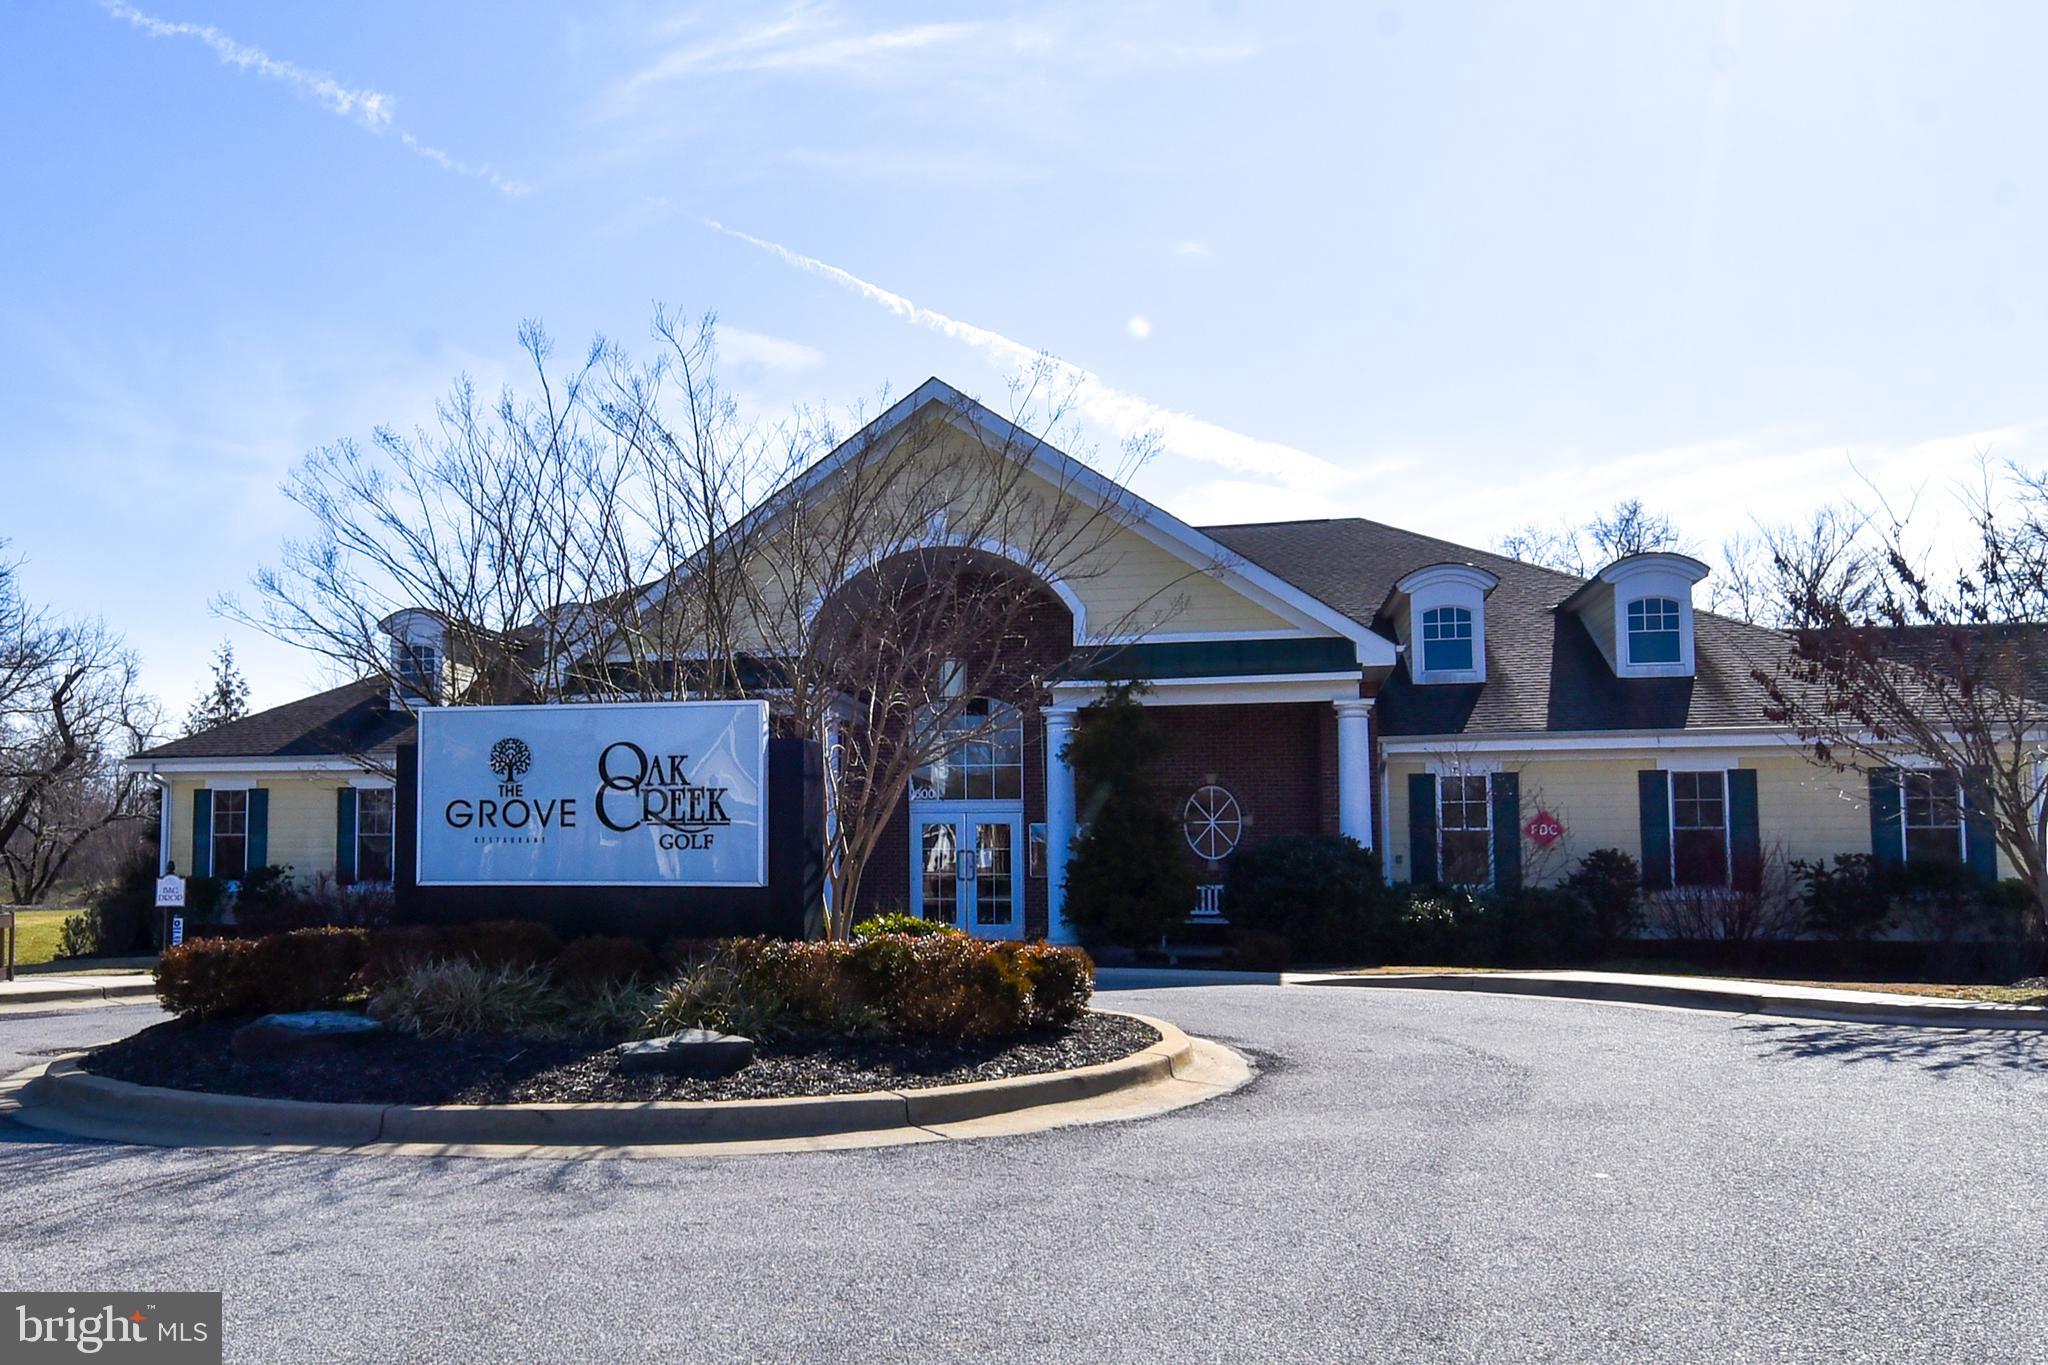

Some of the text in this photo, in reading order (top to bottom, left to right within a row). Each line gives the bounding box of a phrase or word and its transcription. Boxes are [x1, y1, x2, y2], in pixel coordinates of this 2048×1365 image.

[598, 741, 691, 790] OAK
[498, 784, 523, 797] THE
[445, 798, 576, 828] GROVE
[595, 776, 731, 833] CREEK
[659, 833, 714, 850] GOLF
[1531, 824, 1557, 836] FDC
